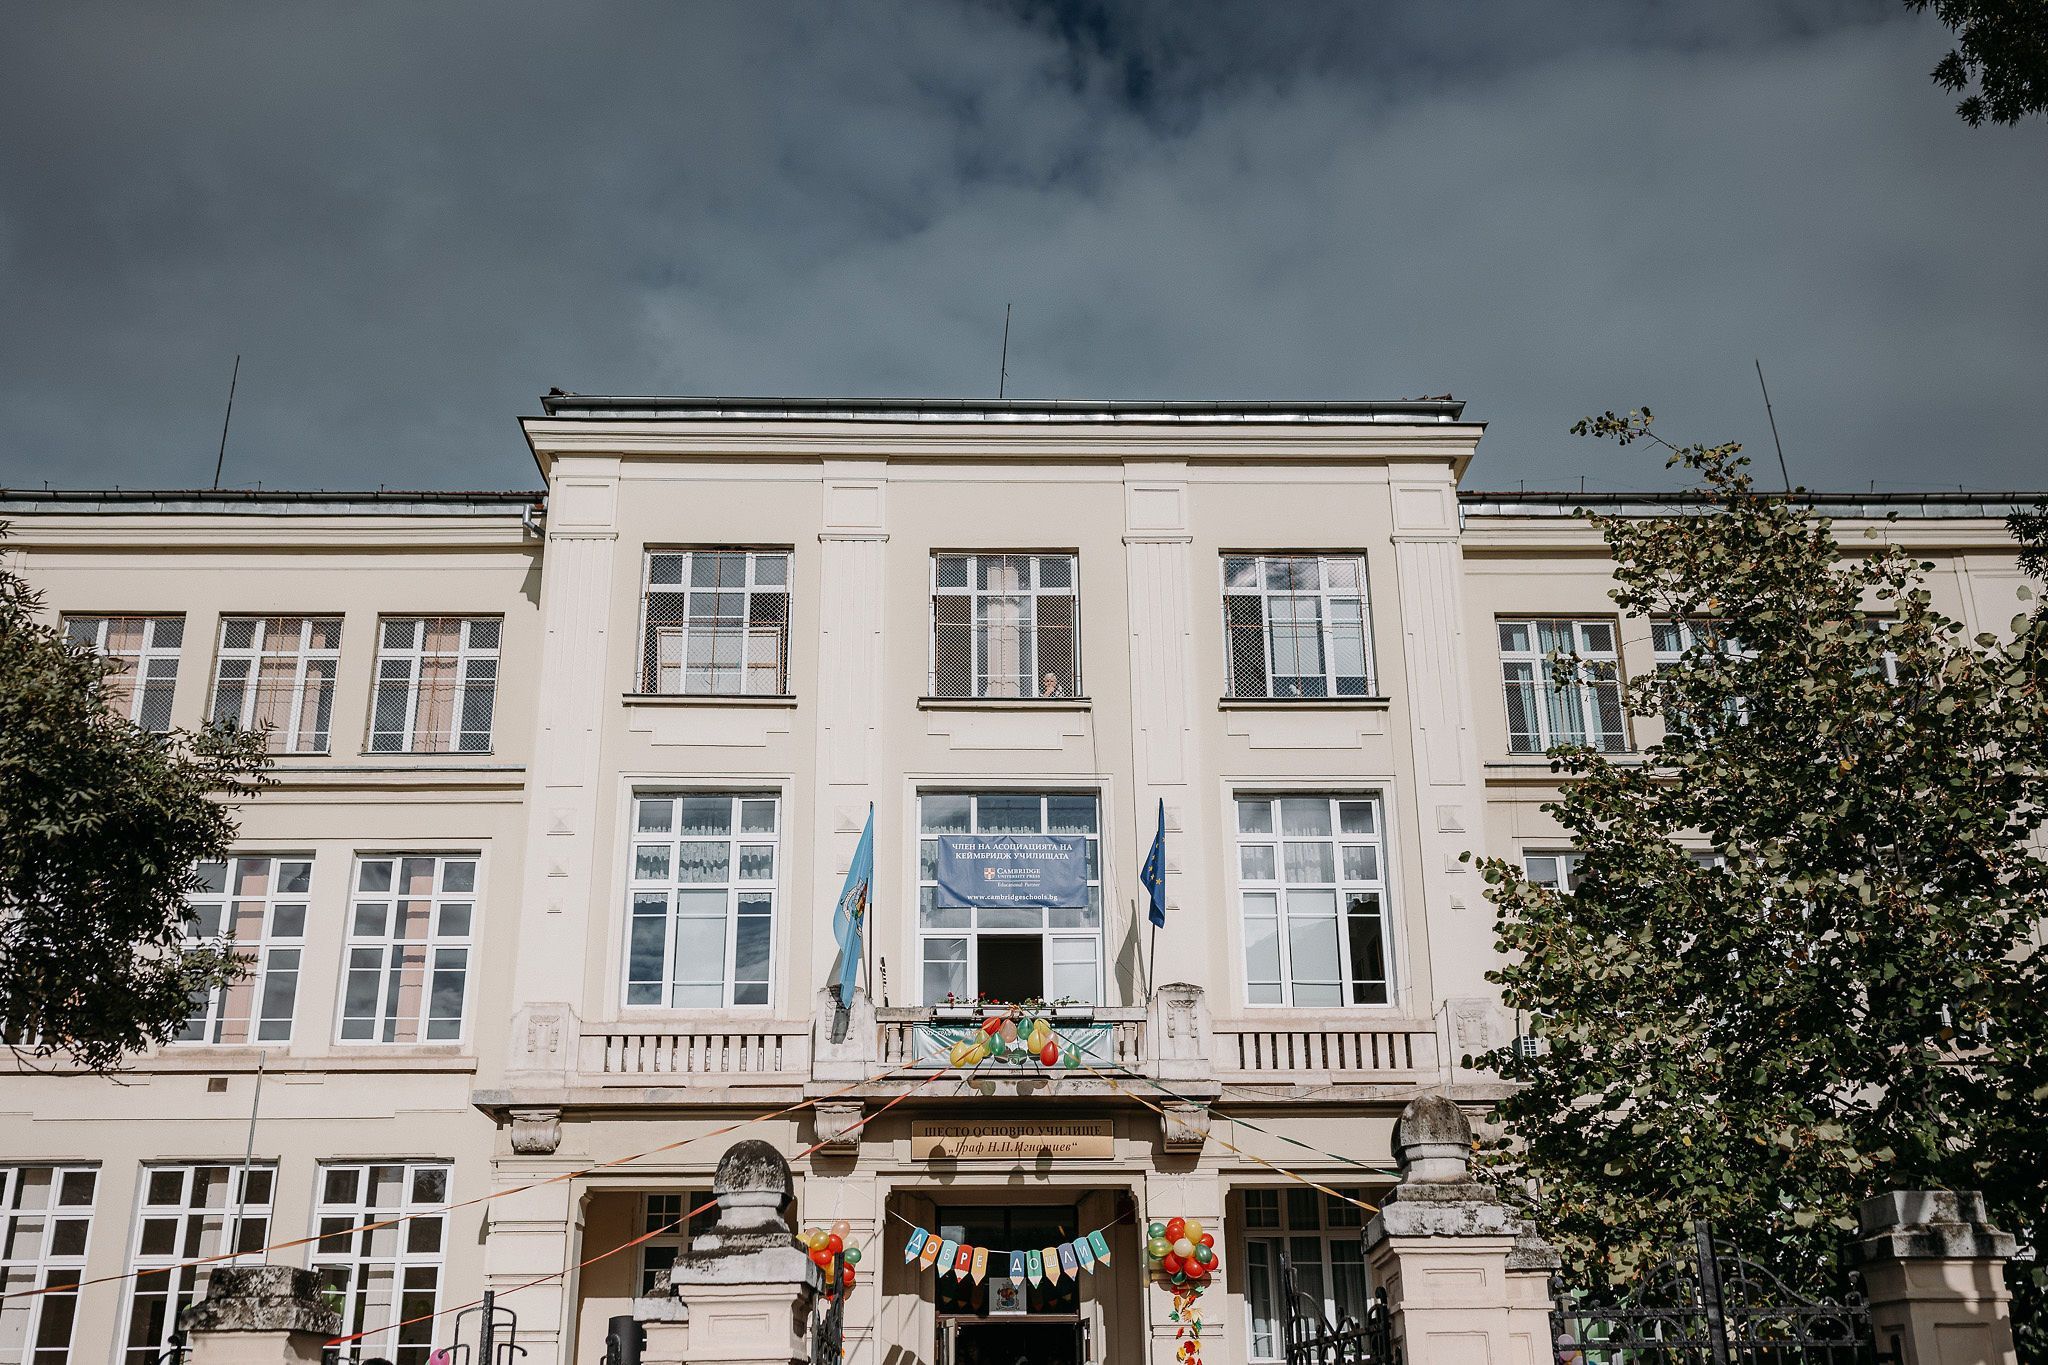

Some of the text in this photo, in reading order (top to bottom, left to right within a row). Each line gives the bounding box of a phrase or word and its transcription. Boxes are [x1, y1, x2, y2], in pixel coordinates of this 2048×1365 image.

[993, 843, 1058, 851] АСОЦИАЦИЯТА
[955, 852, 1069, 861] КЕЙМБРИДЖ УЧИЛИЩАТА
[967, 894, 1058, 902] www.cambridgeschools.bg
[924, 1126, 1101, 1137] ШЕСТО ОСНОВНО УЧИЛИЩЕ
[909, 1233, 1104, 1273] ДОБРЕ ДОШЛИ!
